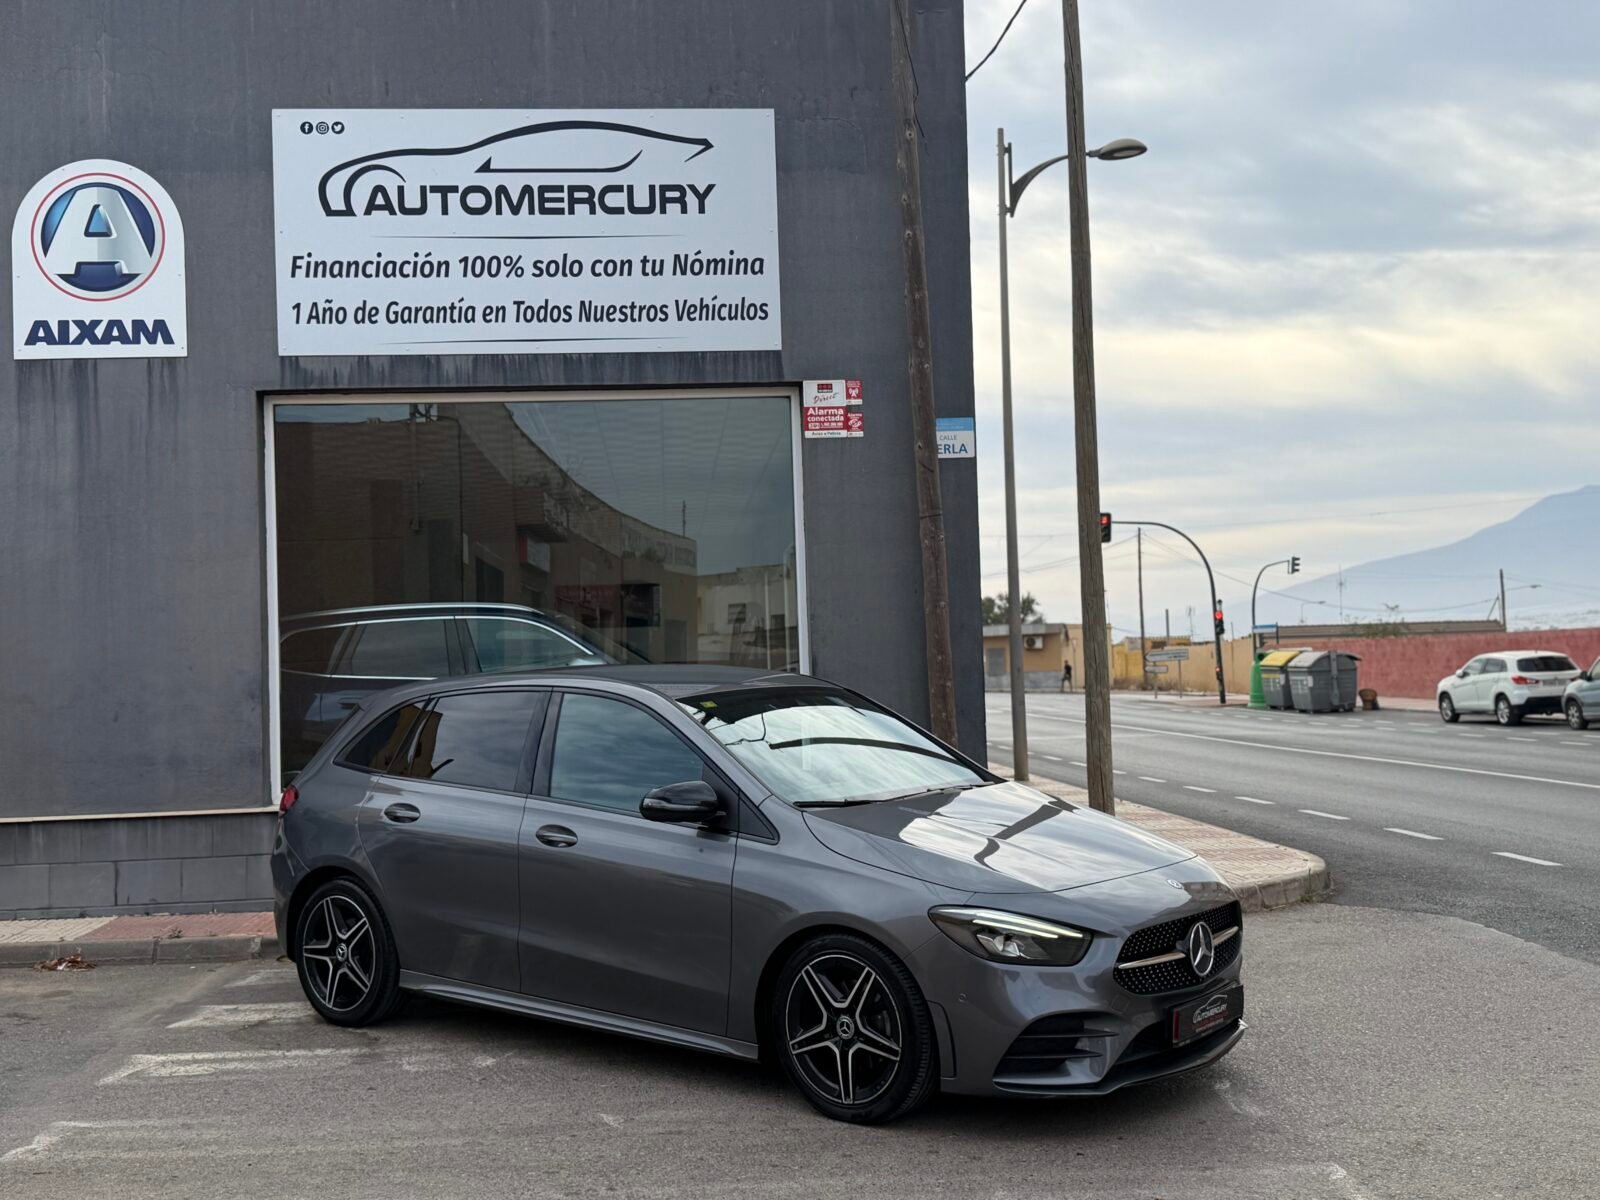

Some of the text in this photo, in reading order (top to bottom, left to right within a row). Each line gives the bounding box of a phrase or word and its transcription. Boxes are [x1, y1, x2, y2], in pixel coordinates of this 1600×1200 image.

[363, 183, 717, 217] AUTOMERCURY
[290, 249, 765, 279] Financiación 100% solo con tu Nómina
[291, 294, 769, 325] 1 Año de Garantía en Todos Nuestros Vehículos
[24, 319, 175, 346] AIXAM
[807, 407, 844, 415] Alarma
[937, 443, 968, 455] ERLA
